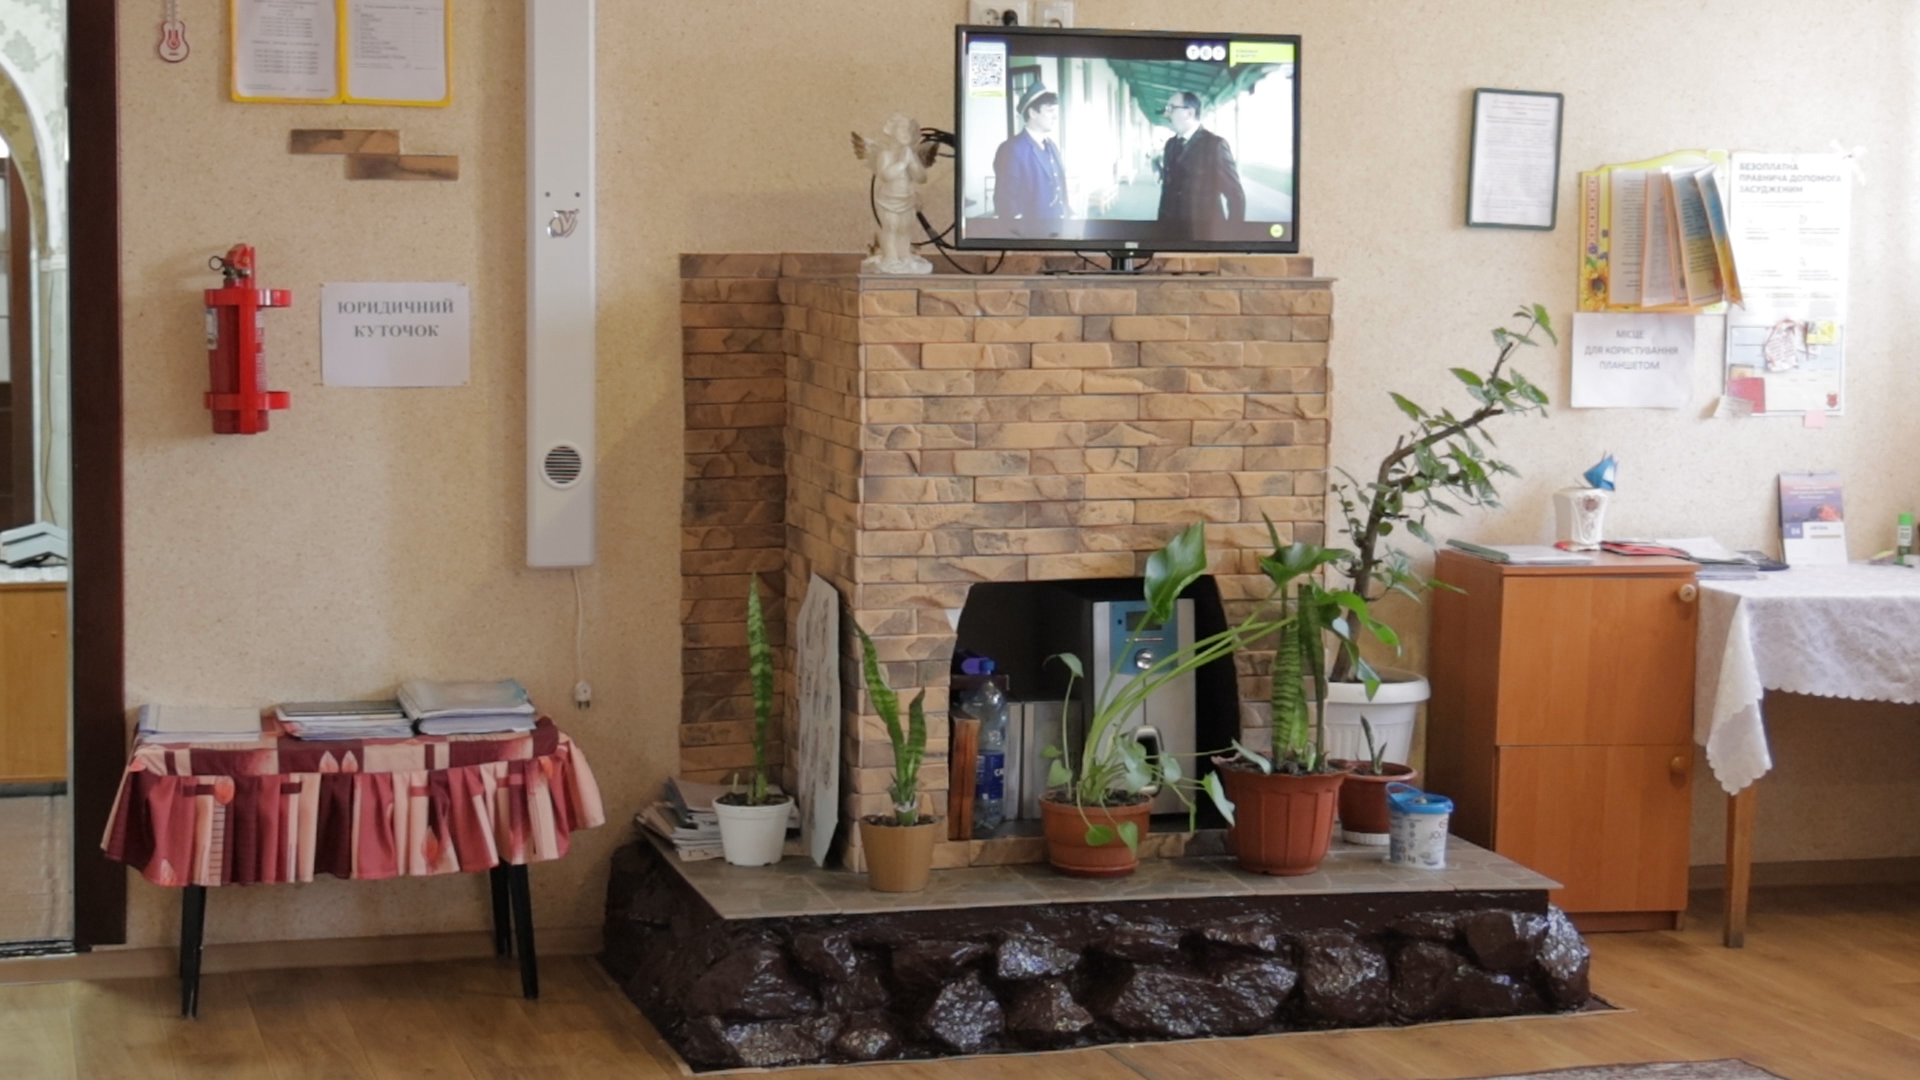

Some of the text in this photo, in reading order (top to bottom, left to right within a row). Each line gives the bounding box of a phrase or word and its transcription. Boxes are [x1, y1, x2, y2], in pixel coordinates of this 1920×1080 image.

[1739, 162, 1799, 171] БЕЗОПЛАТНА
[1739, 174, 1842, 183] ПРАВНИЧА ДОПОМОГА
[1739, 185, 1803, 194] ЗАСУДЖЕНИМ
[338, 298, 454, 315] ЮРИДИЧНИЙ
[354, 324, 439, 338] КУТОЧОК
[1616, 330, 1644, 339] МІСЦЕ
[1584, 346, 1679, 355] ДЛЯ КОРИСТУВАННЯ
[1600, 361, 1660, 370] ПЛАНШЕТОМ
